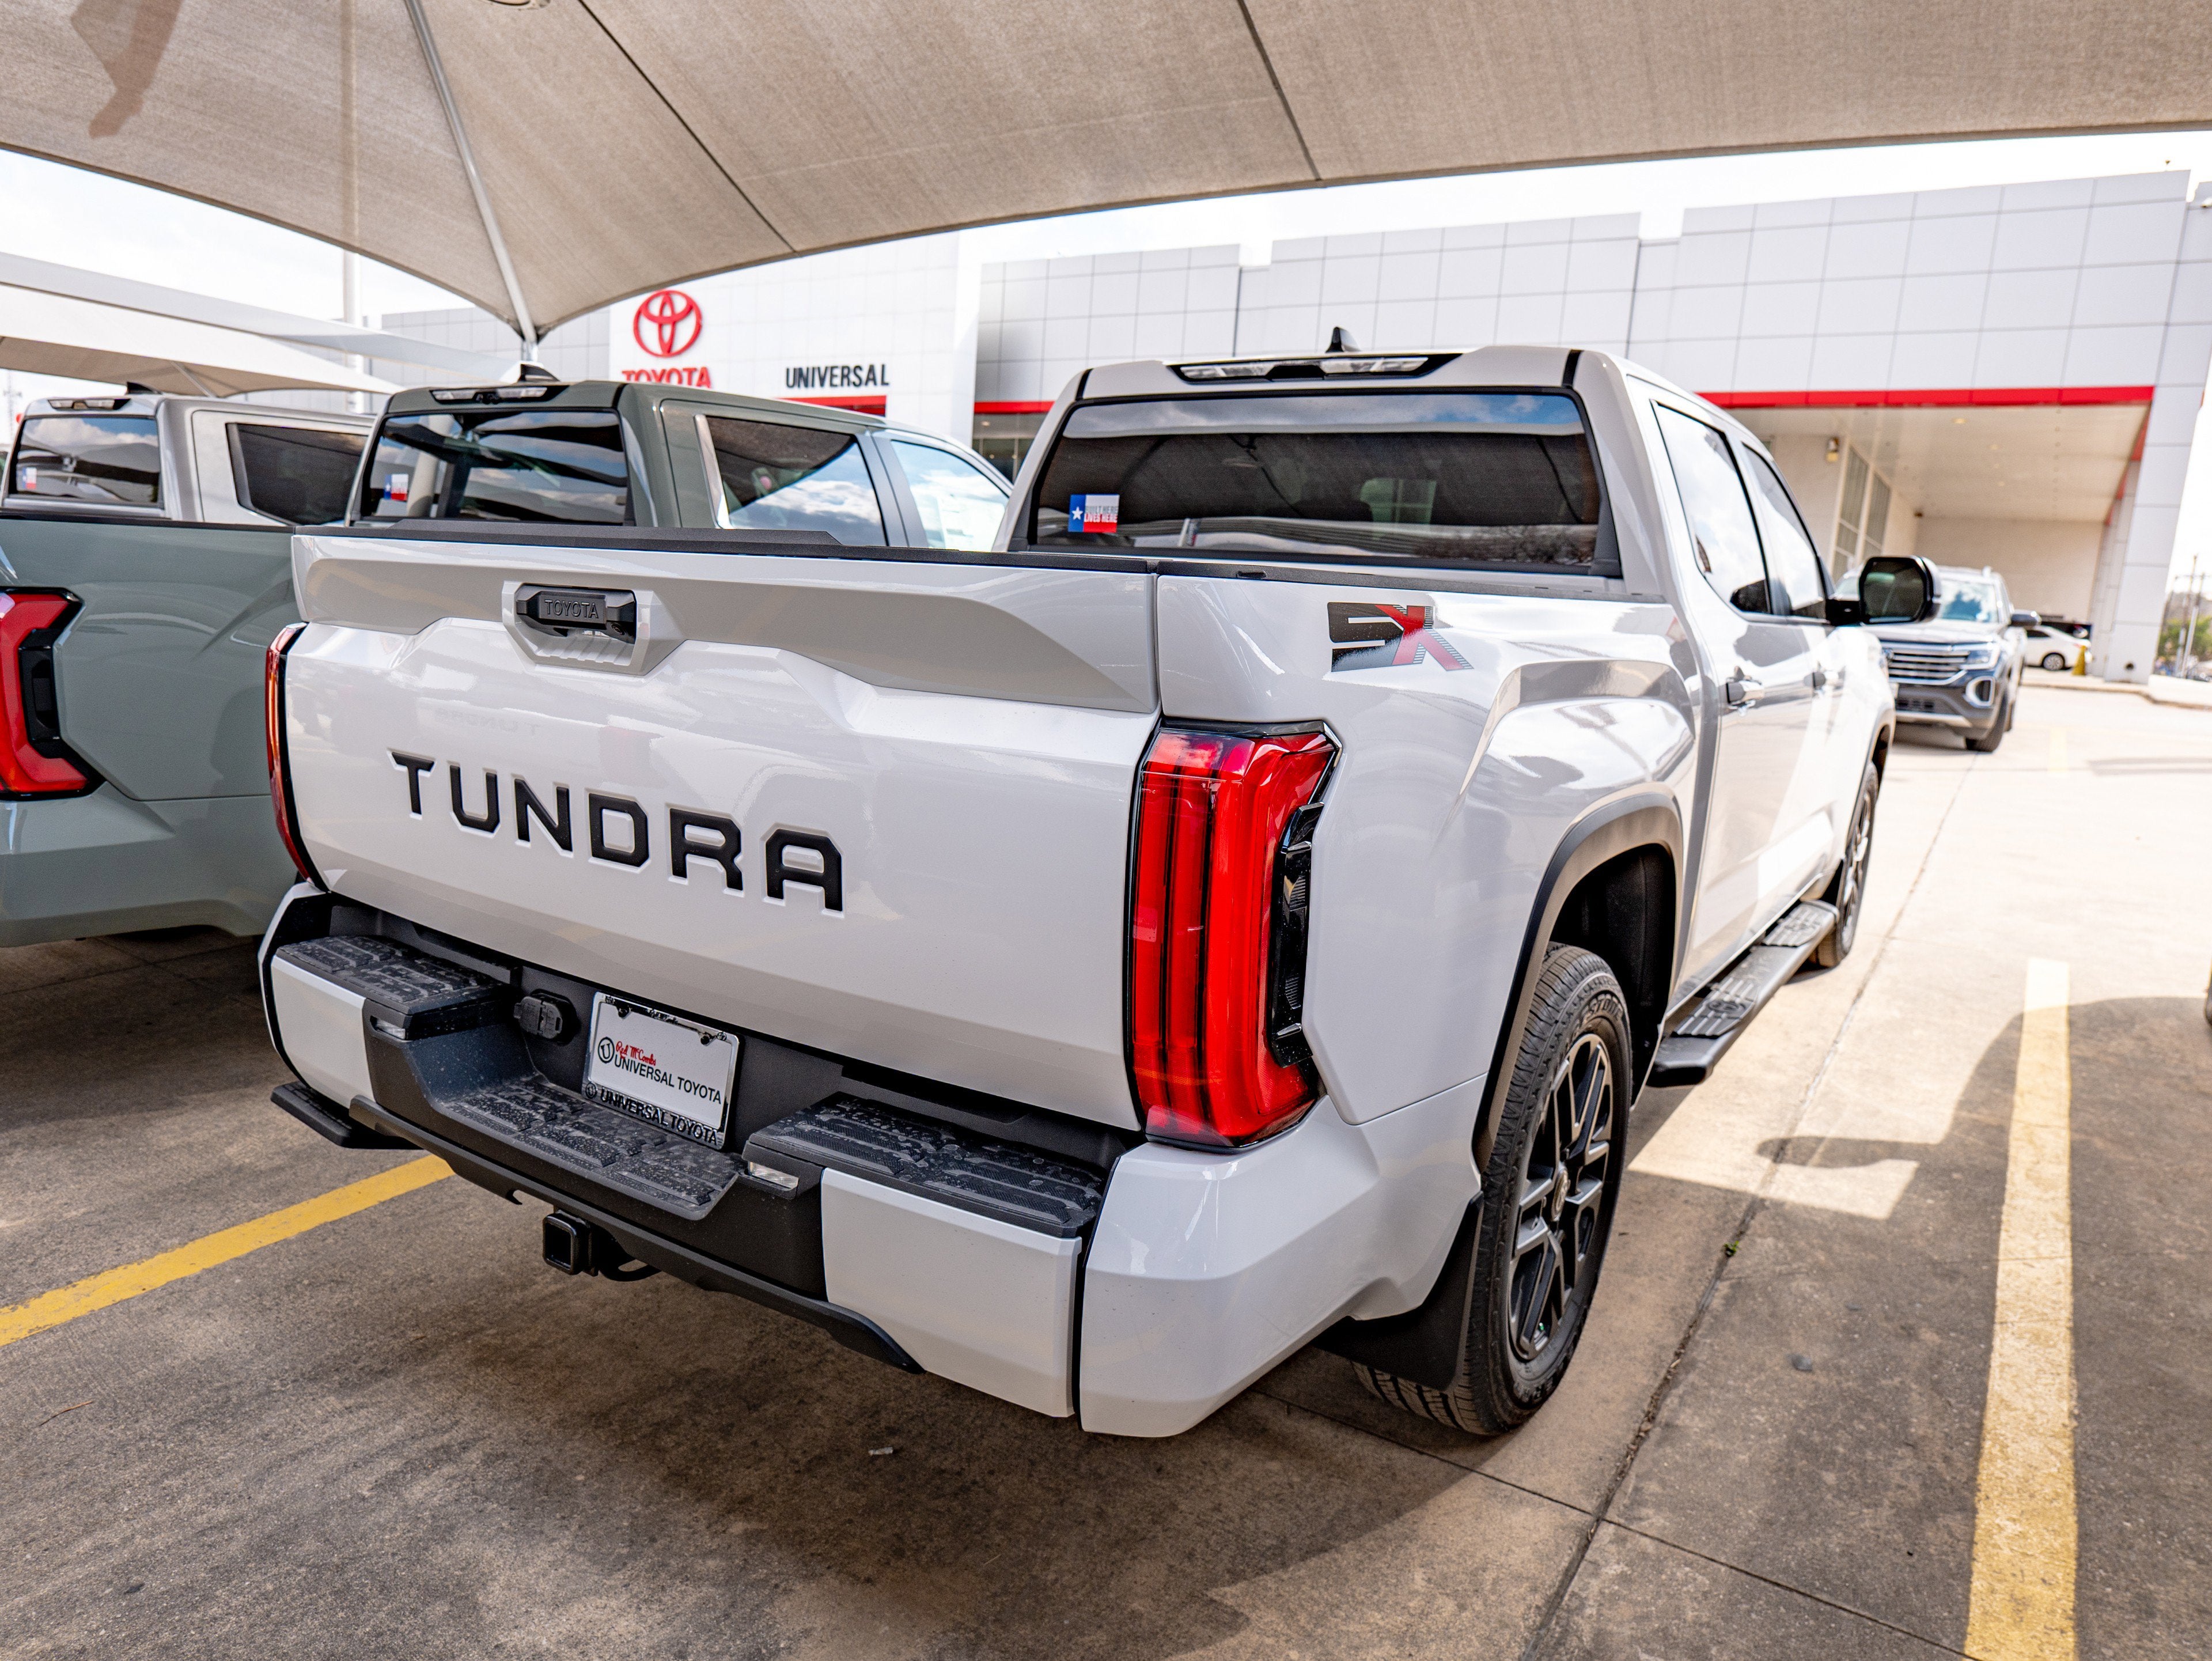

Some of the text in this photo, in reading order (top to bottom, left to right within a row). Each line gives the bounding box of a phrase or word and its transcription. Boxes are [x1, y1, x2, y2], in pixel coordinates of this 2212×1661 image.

[786, 364, 889, 388] UNIVERSAL
[544, 599, 599, 619] TOYOTA
[391, 751, 843, 913] TUNDRA
[616, 1041, 656, 1066] Red McCombs
[615, 1054, 721, 1104] UNIVERSAL TOYOTA
[600, 1087, 719, 1145] UNIVERSAL TOYOTA
